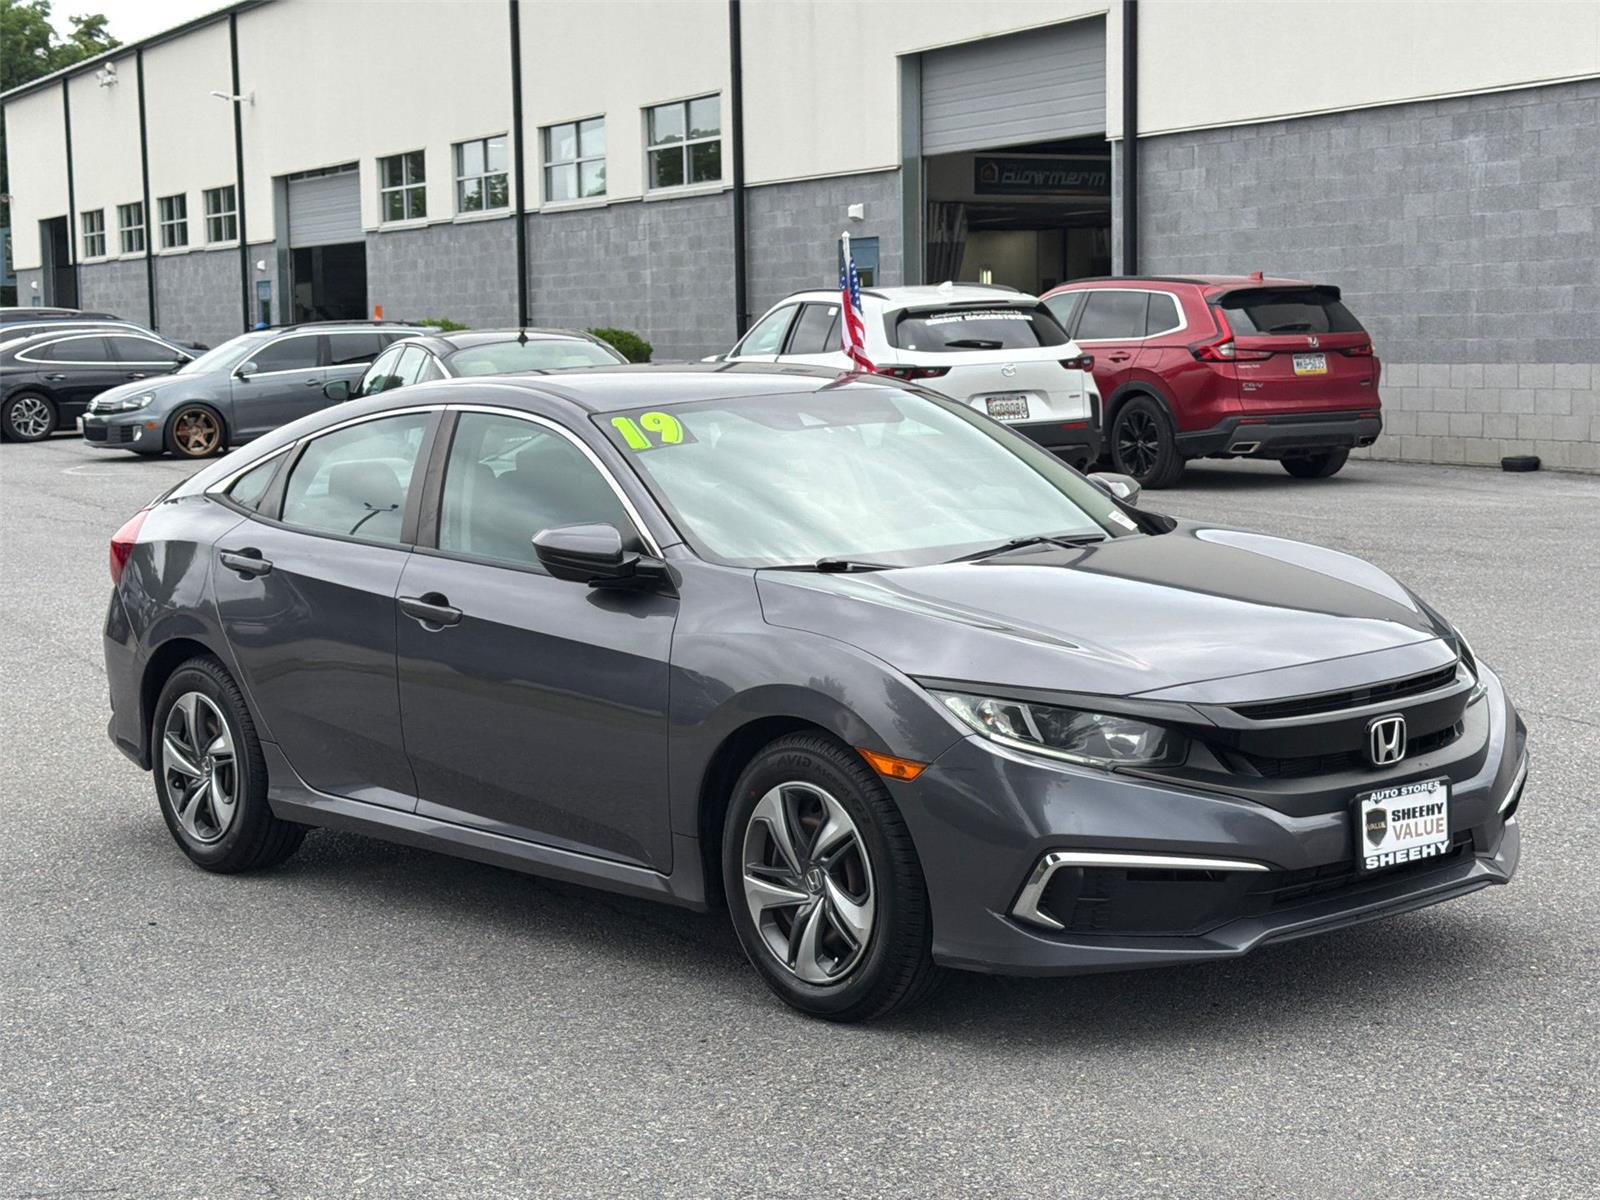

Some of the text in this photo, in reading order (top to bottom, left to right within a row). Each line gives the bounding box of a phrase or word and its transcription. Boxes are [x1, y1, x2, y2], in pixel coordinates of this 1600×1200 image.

[611, 411, 683, 449] 19
[777, 755, 812, 769] AVID
[1370, 780, 1440, 801] AUTO STORES
[1391, 802, 1444, 822] SHEEHY
[1392, 817, 1445, 841] VALUE
[1366, 840, 1450, 870] SHEEHY
